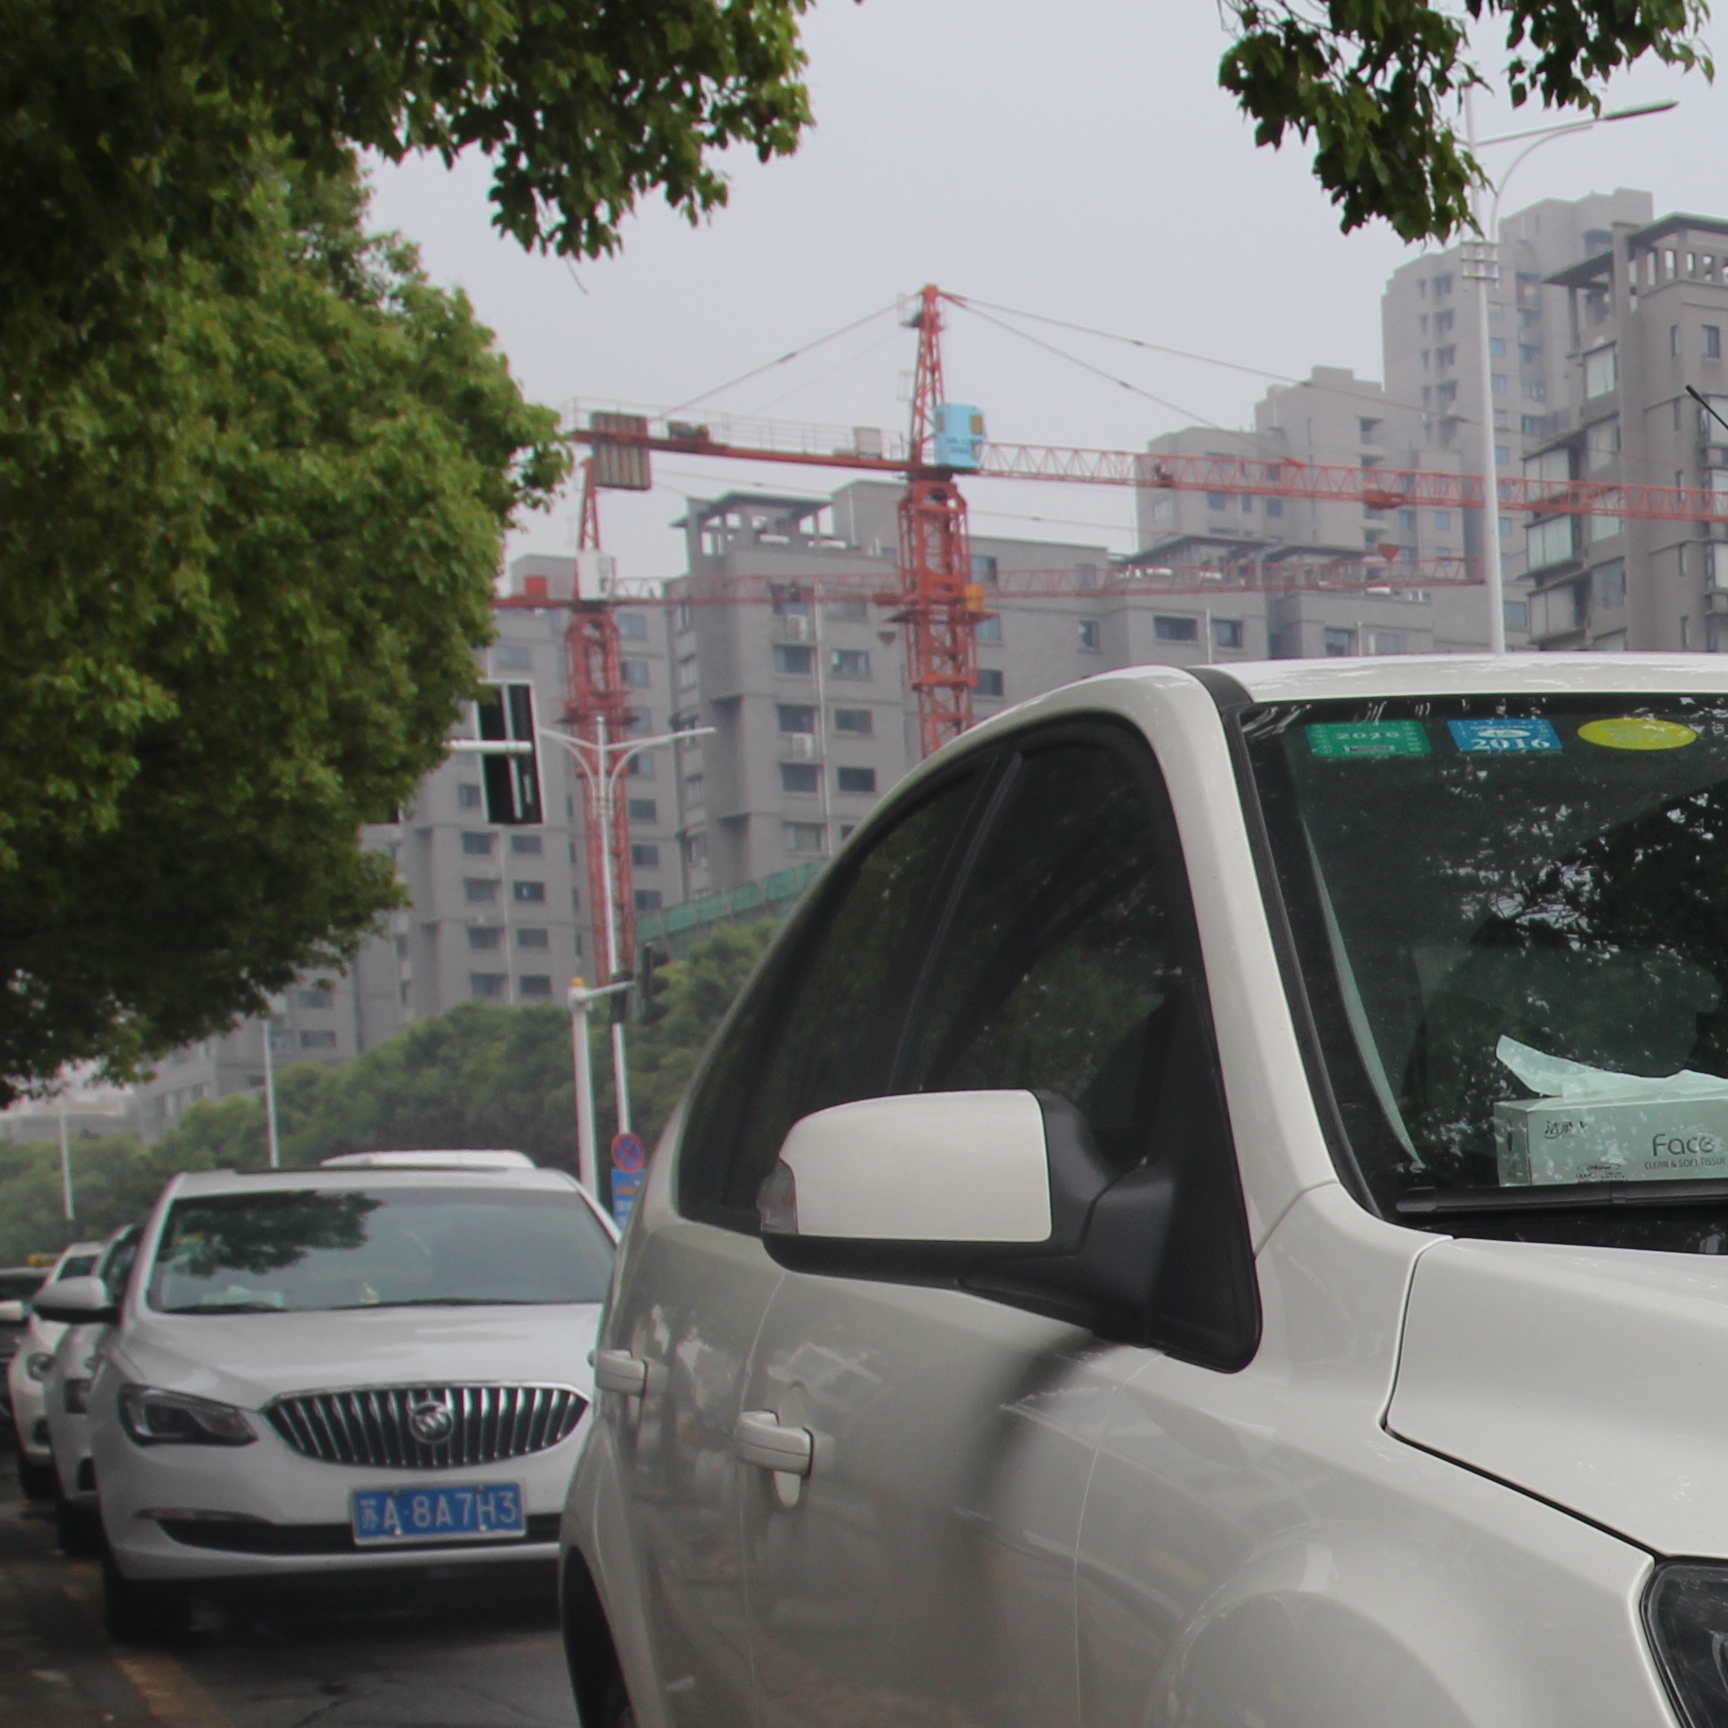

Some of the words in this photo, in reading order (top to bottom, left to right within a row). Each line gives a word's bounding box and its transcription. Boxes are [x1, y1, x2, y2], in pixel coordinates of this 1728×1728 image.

[1470, 738, 1551, 749] 2016
[1651, 1133, 1716, 1156] Face
[1644, 1161, 1669, 1170] CLEAN
[1678, 1158, 1698, 1168] SOFT
[1701, 1157, 1726, 1166] TISSUE
